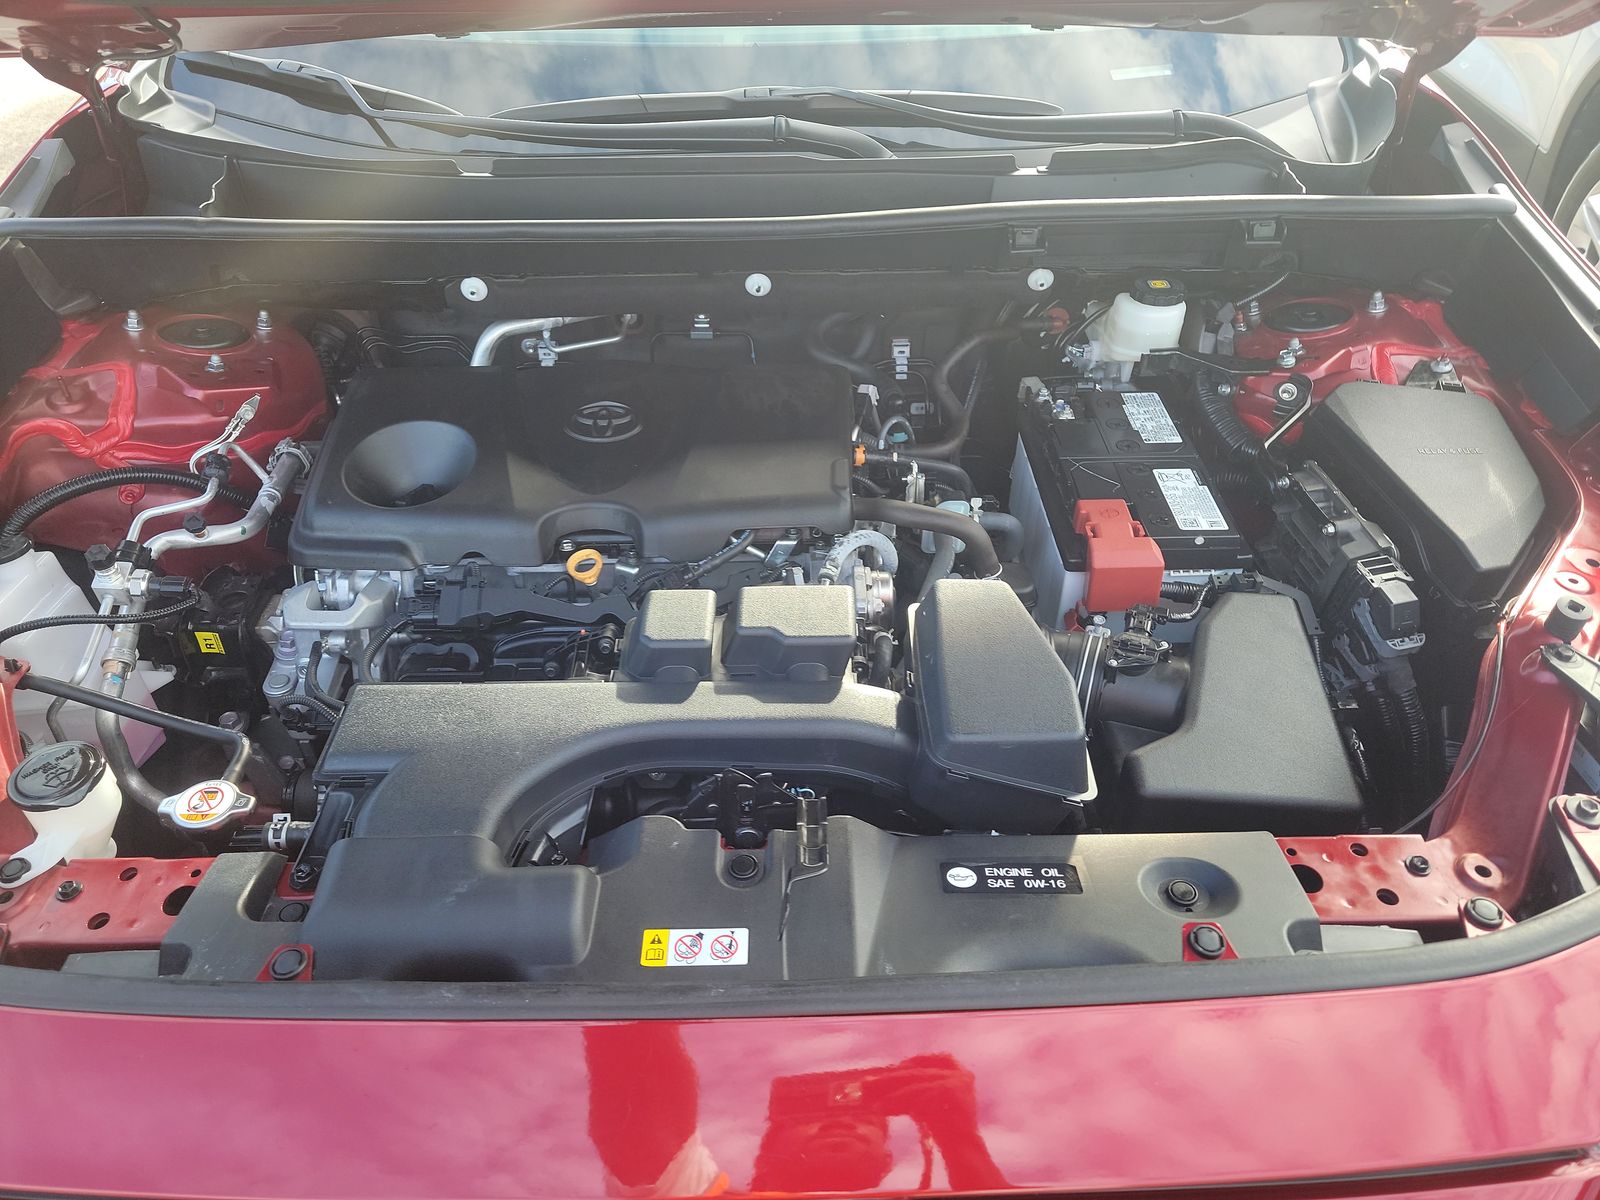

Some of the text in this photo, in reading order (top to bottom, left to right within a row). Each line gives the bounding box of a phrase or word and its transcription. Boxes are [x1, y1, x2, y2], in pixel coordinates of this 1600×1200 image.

[984, 867, 1065, 877] ENGINE OIL
[987, 878, 1067, 889] SAE 0W-16
